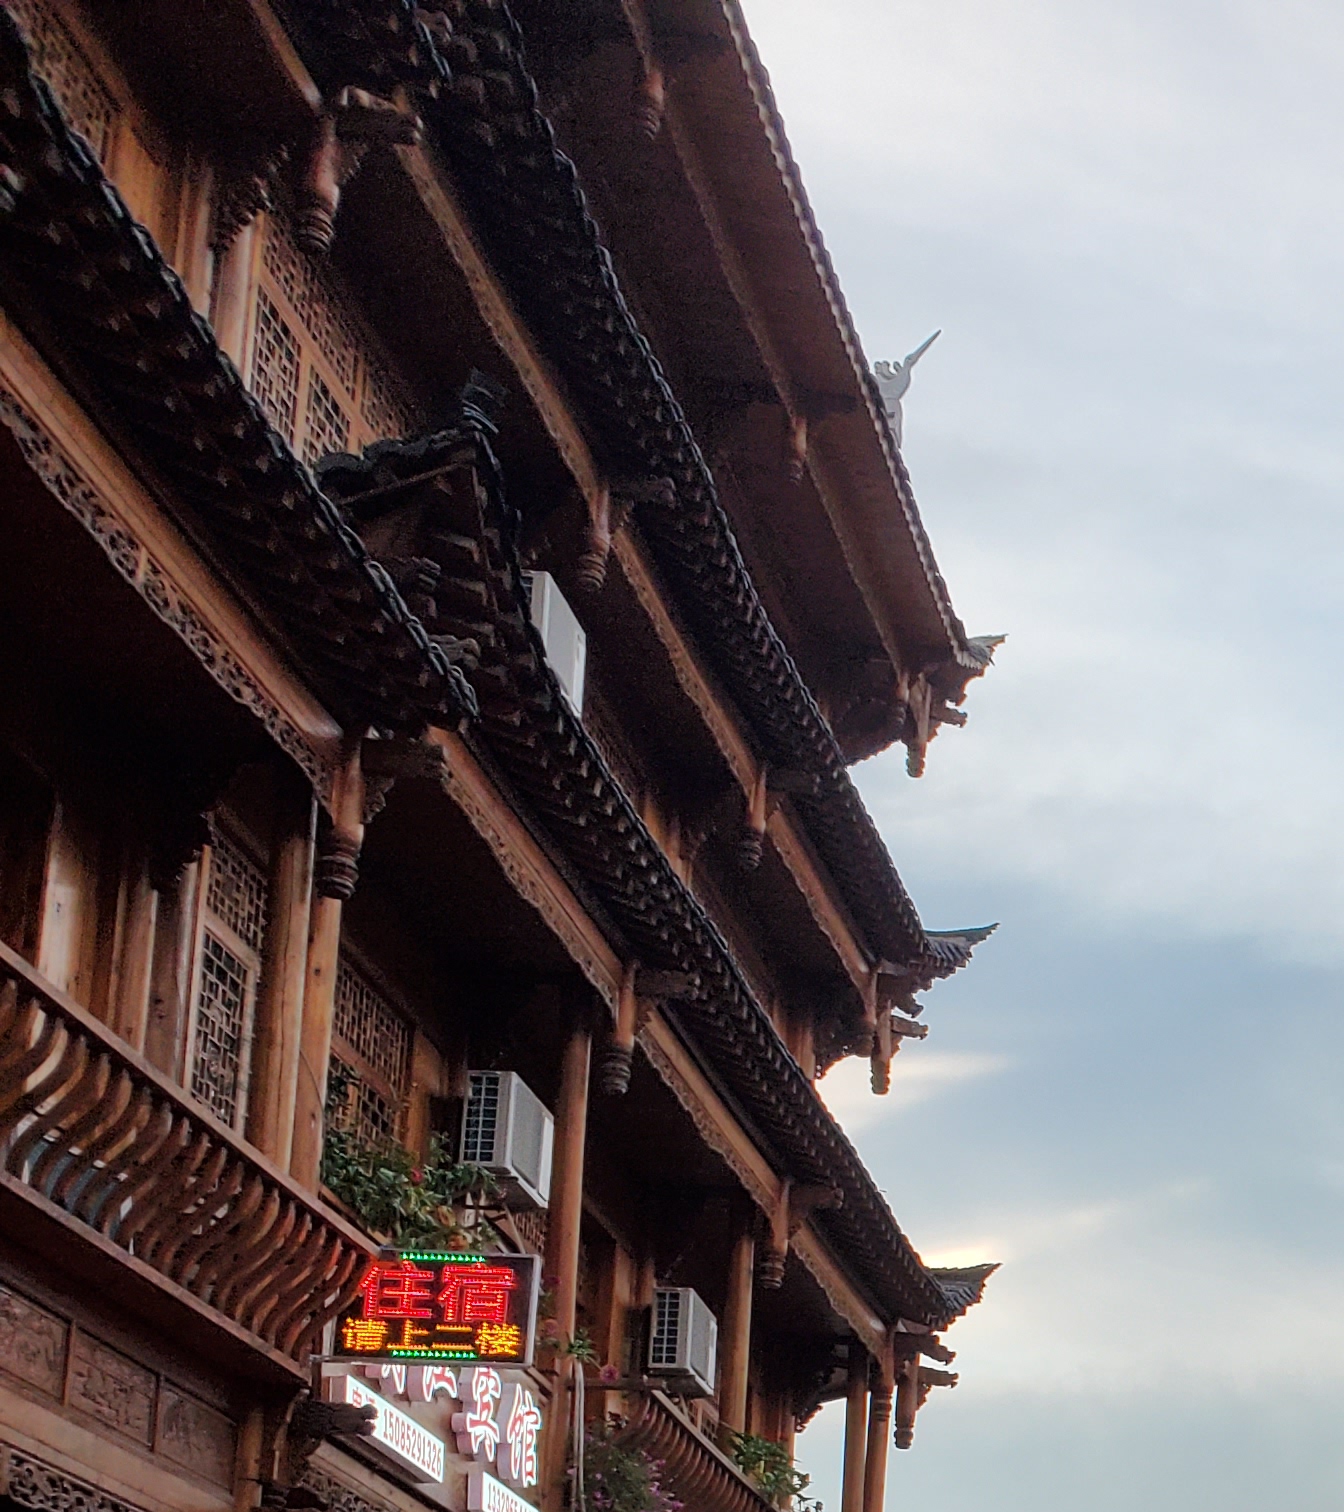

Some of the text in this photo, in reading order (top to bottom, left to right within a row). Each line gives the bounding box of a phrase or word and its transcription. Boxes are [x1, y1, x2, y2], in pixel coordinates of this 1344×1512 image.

[361, 1260, 516, 1322] 住宿
[343, 1317, 521, 1355] 请上二楼
[383, 1408, 442, 1477] 15085291326
